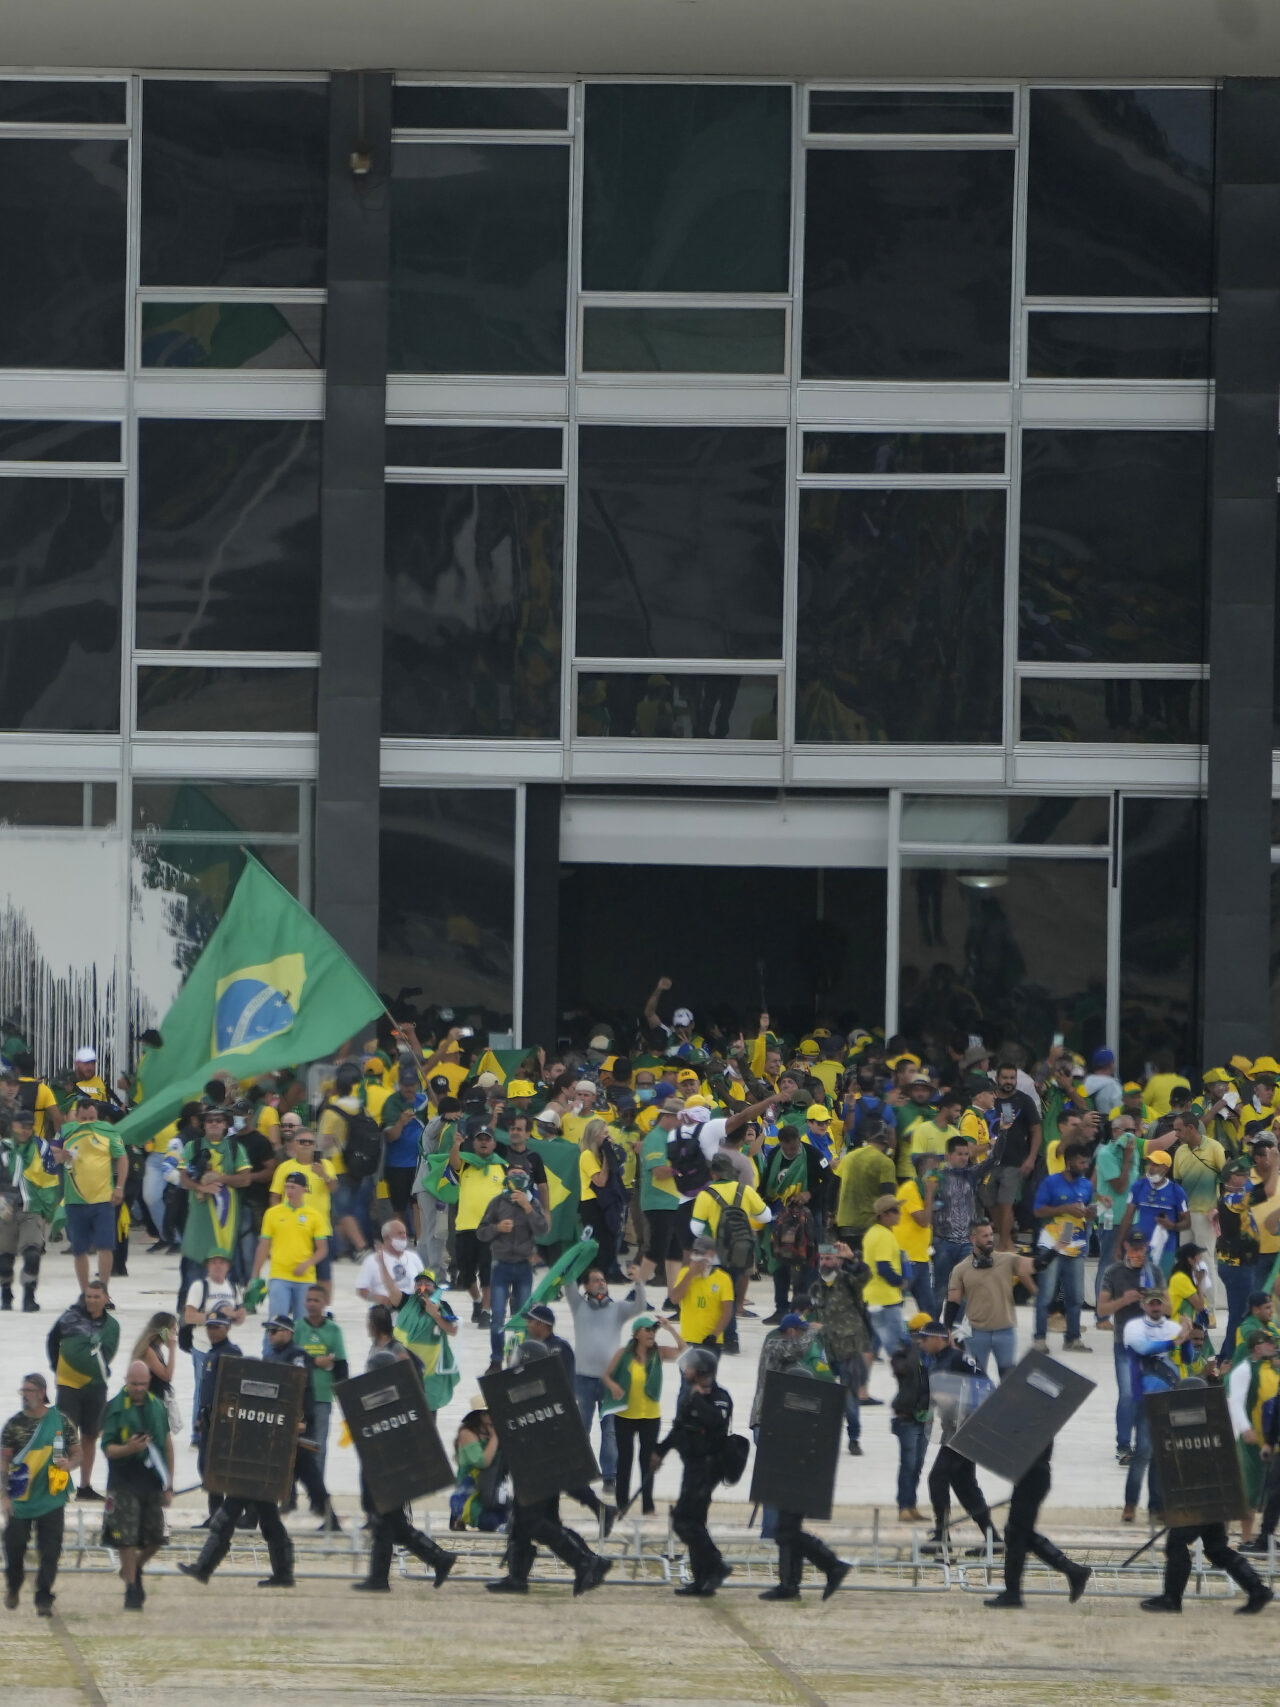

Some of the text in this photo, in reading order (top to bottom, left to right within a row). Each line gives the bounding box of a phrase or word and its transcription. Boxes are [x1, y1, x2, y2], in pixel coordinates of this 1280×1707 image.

[227, 1407, 286, 1426] CHOQUE
[362, 1409, 419, 1438] CHOQUE
[507, 1403, 565, 1430] CHOQUE
